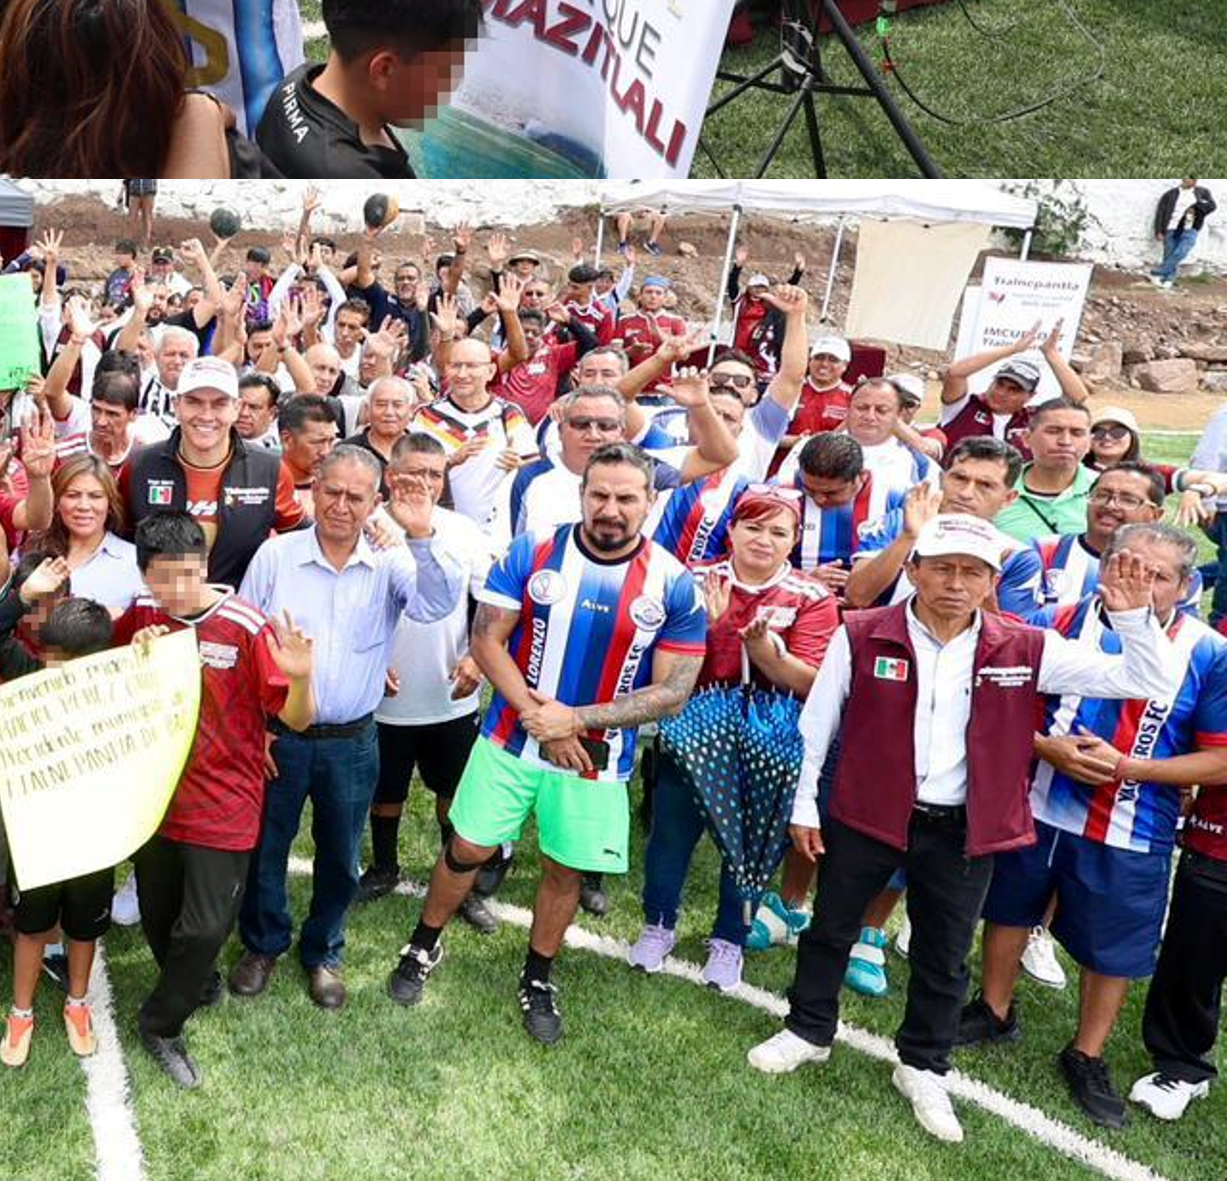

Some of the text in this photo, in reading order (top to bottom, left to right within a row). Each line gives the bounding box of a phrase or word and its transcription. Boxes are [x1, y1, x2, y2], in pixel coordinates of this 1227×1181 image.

[282, 81, 310, 145] PIRMA
[526, 618, 547, 685] LORENZO
[1145, 699, 1168, 722] FC
